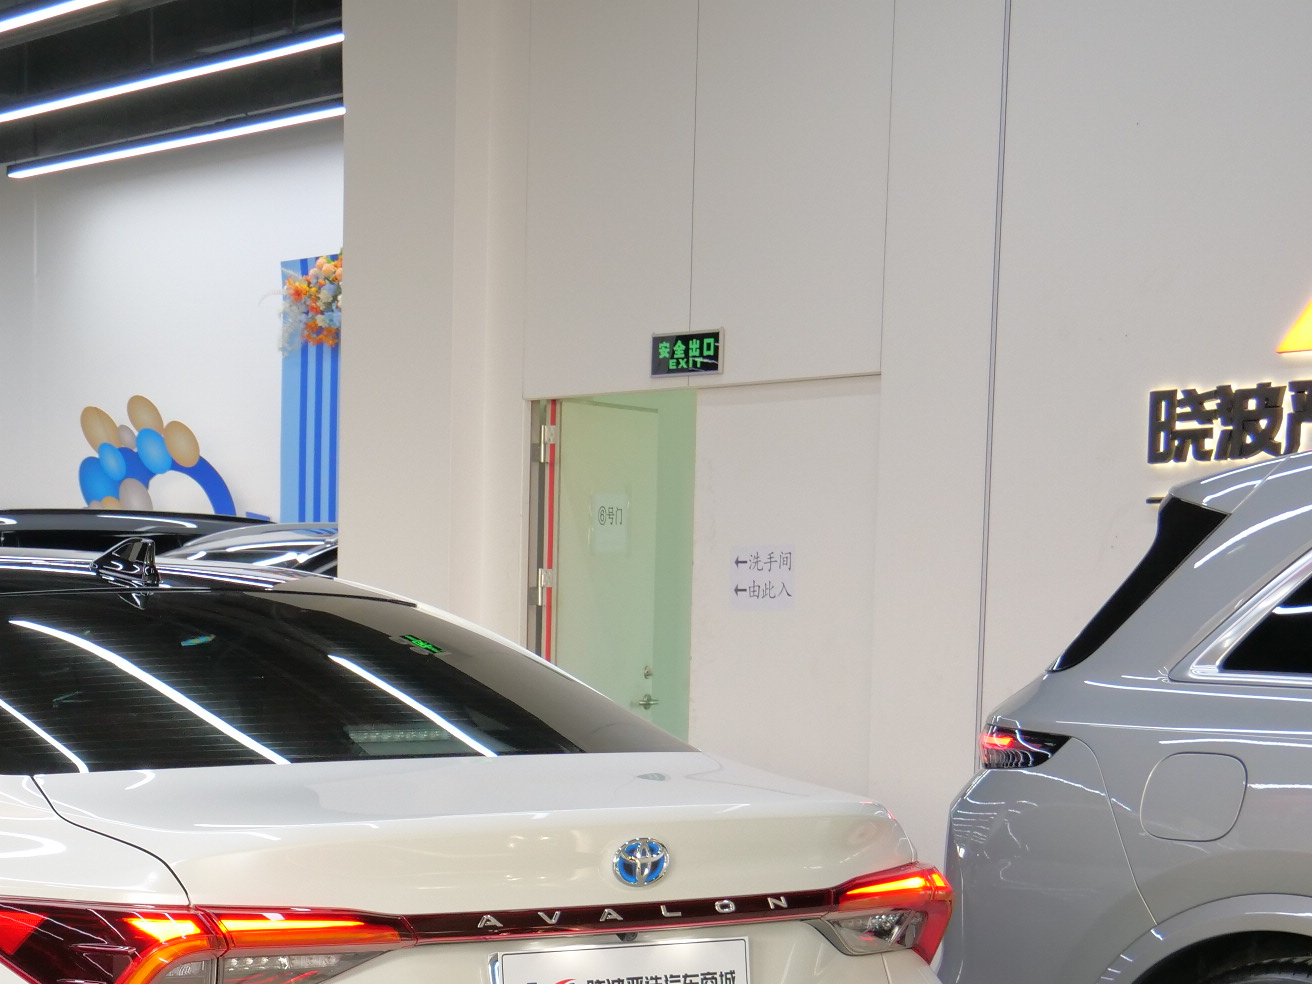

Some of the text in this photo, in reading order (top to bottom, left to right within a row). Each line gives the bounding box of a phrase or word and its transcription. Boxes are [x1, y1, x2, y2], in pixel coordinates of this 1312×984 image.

[658, 337, 715, 359] 安全出口
[668, 357, 702, 369] EXIT
[748, 551, 792, 572] 洗手间
[748, 579, 793, 600] 由此入
[477, 895, 789, 929] AVALON
